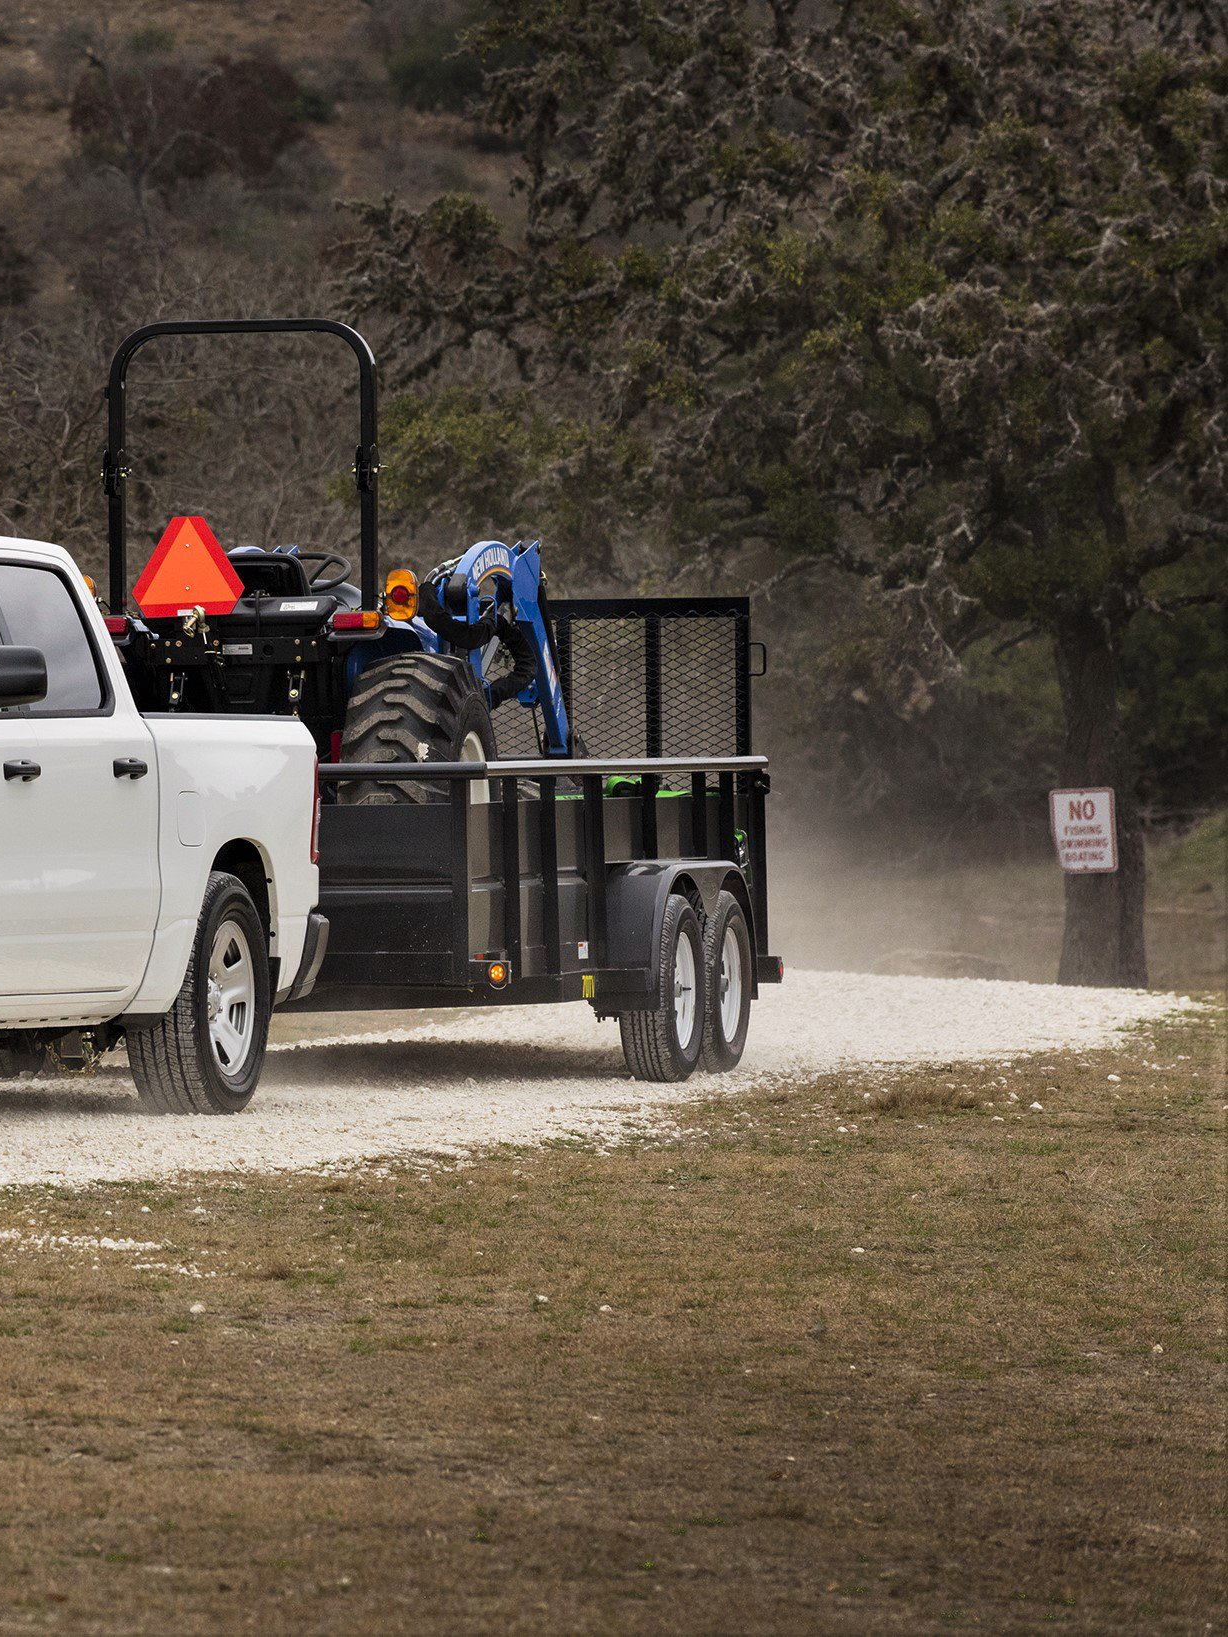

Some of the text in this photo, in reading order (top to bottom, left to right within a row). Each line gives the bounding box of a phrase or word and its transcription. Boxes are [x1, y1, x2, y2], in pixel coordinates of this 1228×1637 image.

[472, 547, 509, 580] NEW HOLLAND
[1068, 799, 1096, 821] NO
